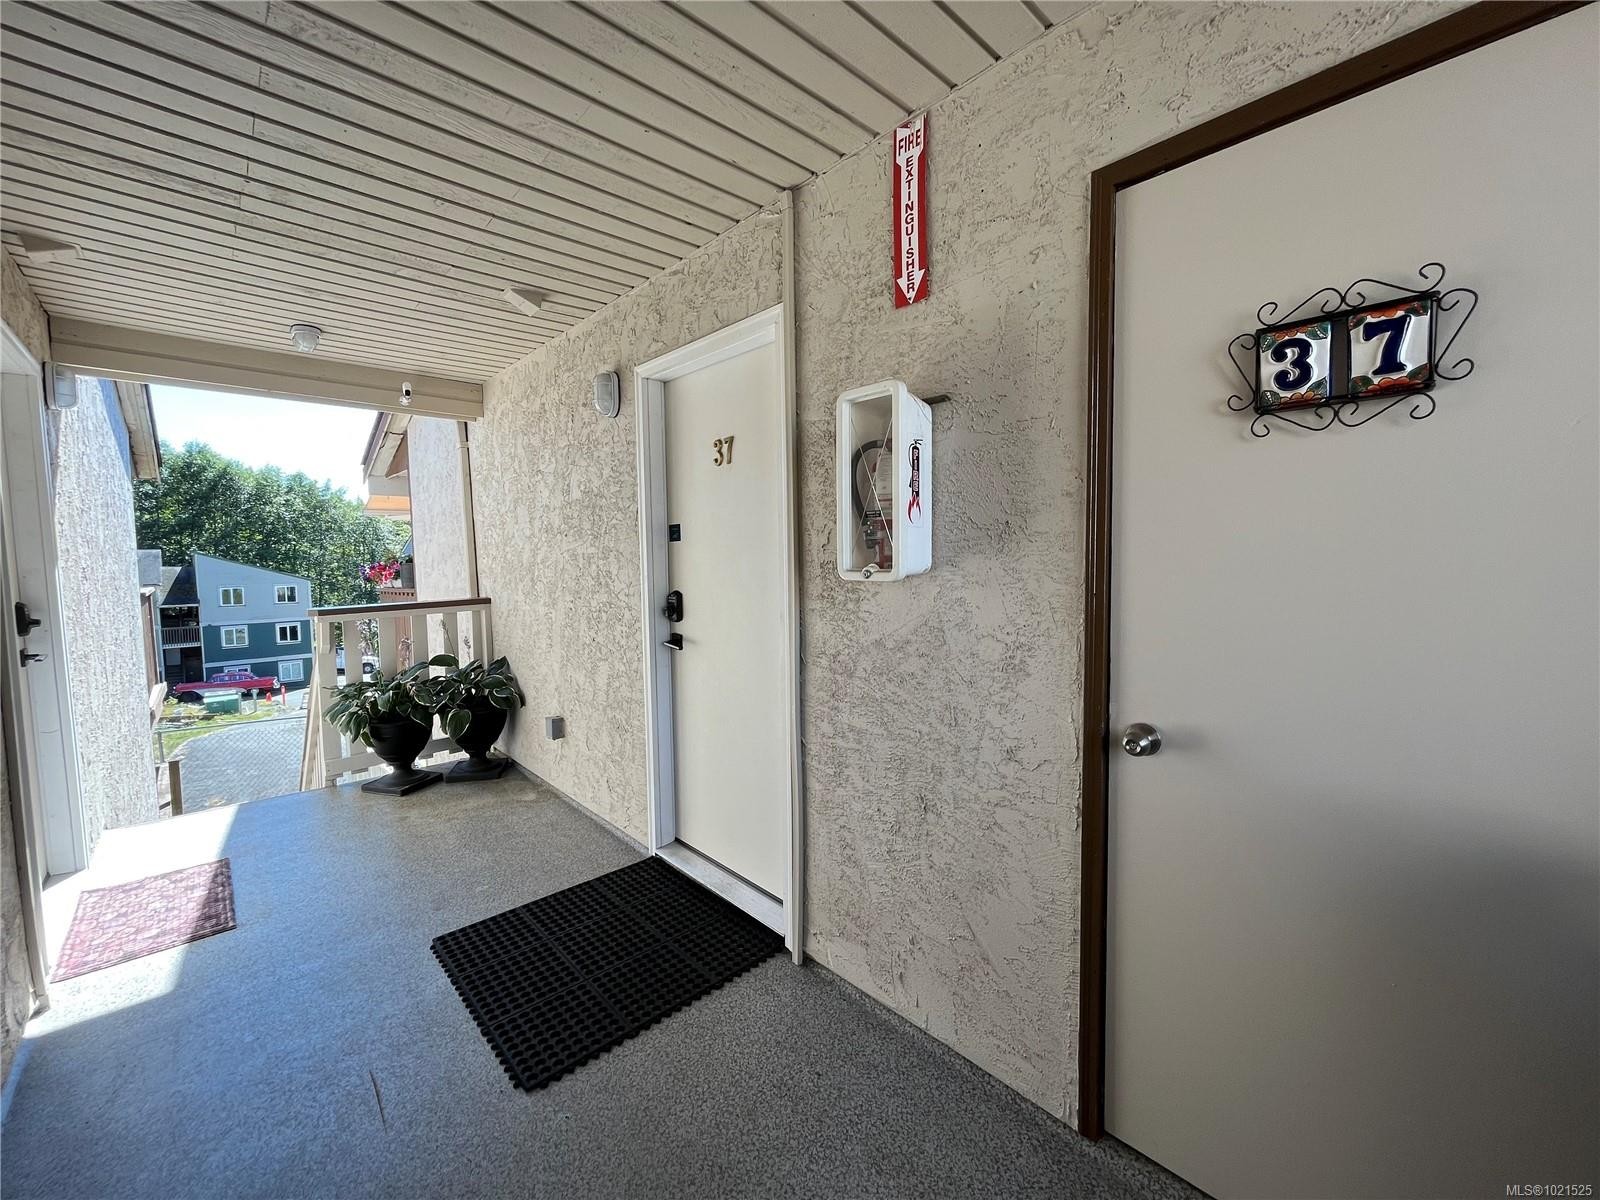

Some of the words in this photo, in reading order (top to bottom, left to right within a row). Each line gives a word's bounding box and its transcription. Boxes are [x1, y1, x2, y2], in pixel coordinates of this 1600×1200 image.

[898, 128, 921, 156] FIRE
[905, 155, 916, 294] EXTINGUISHER
[713, 435, 735, 467] 37
